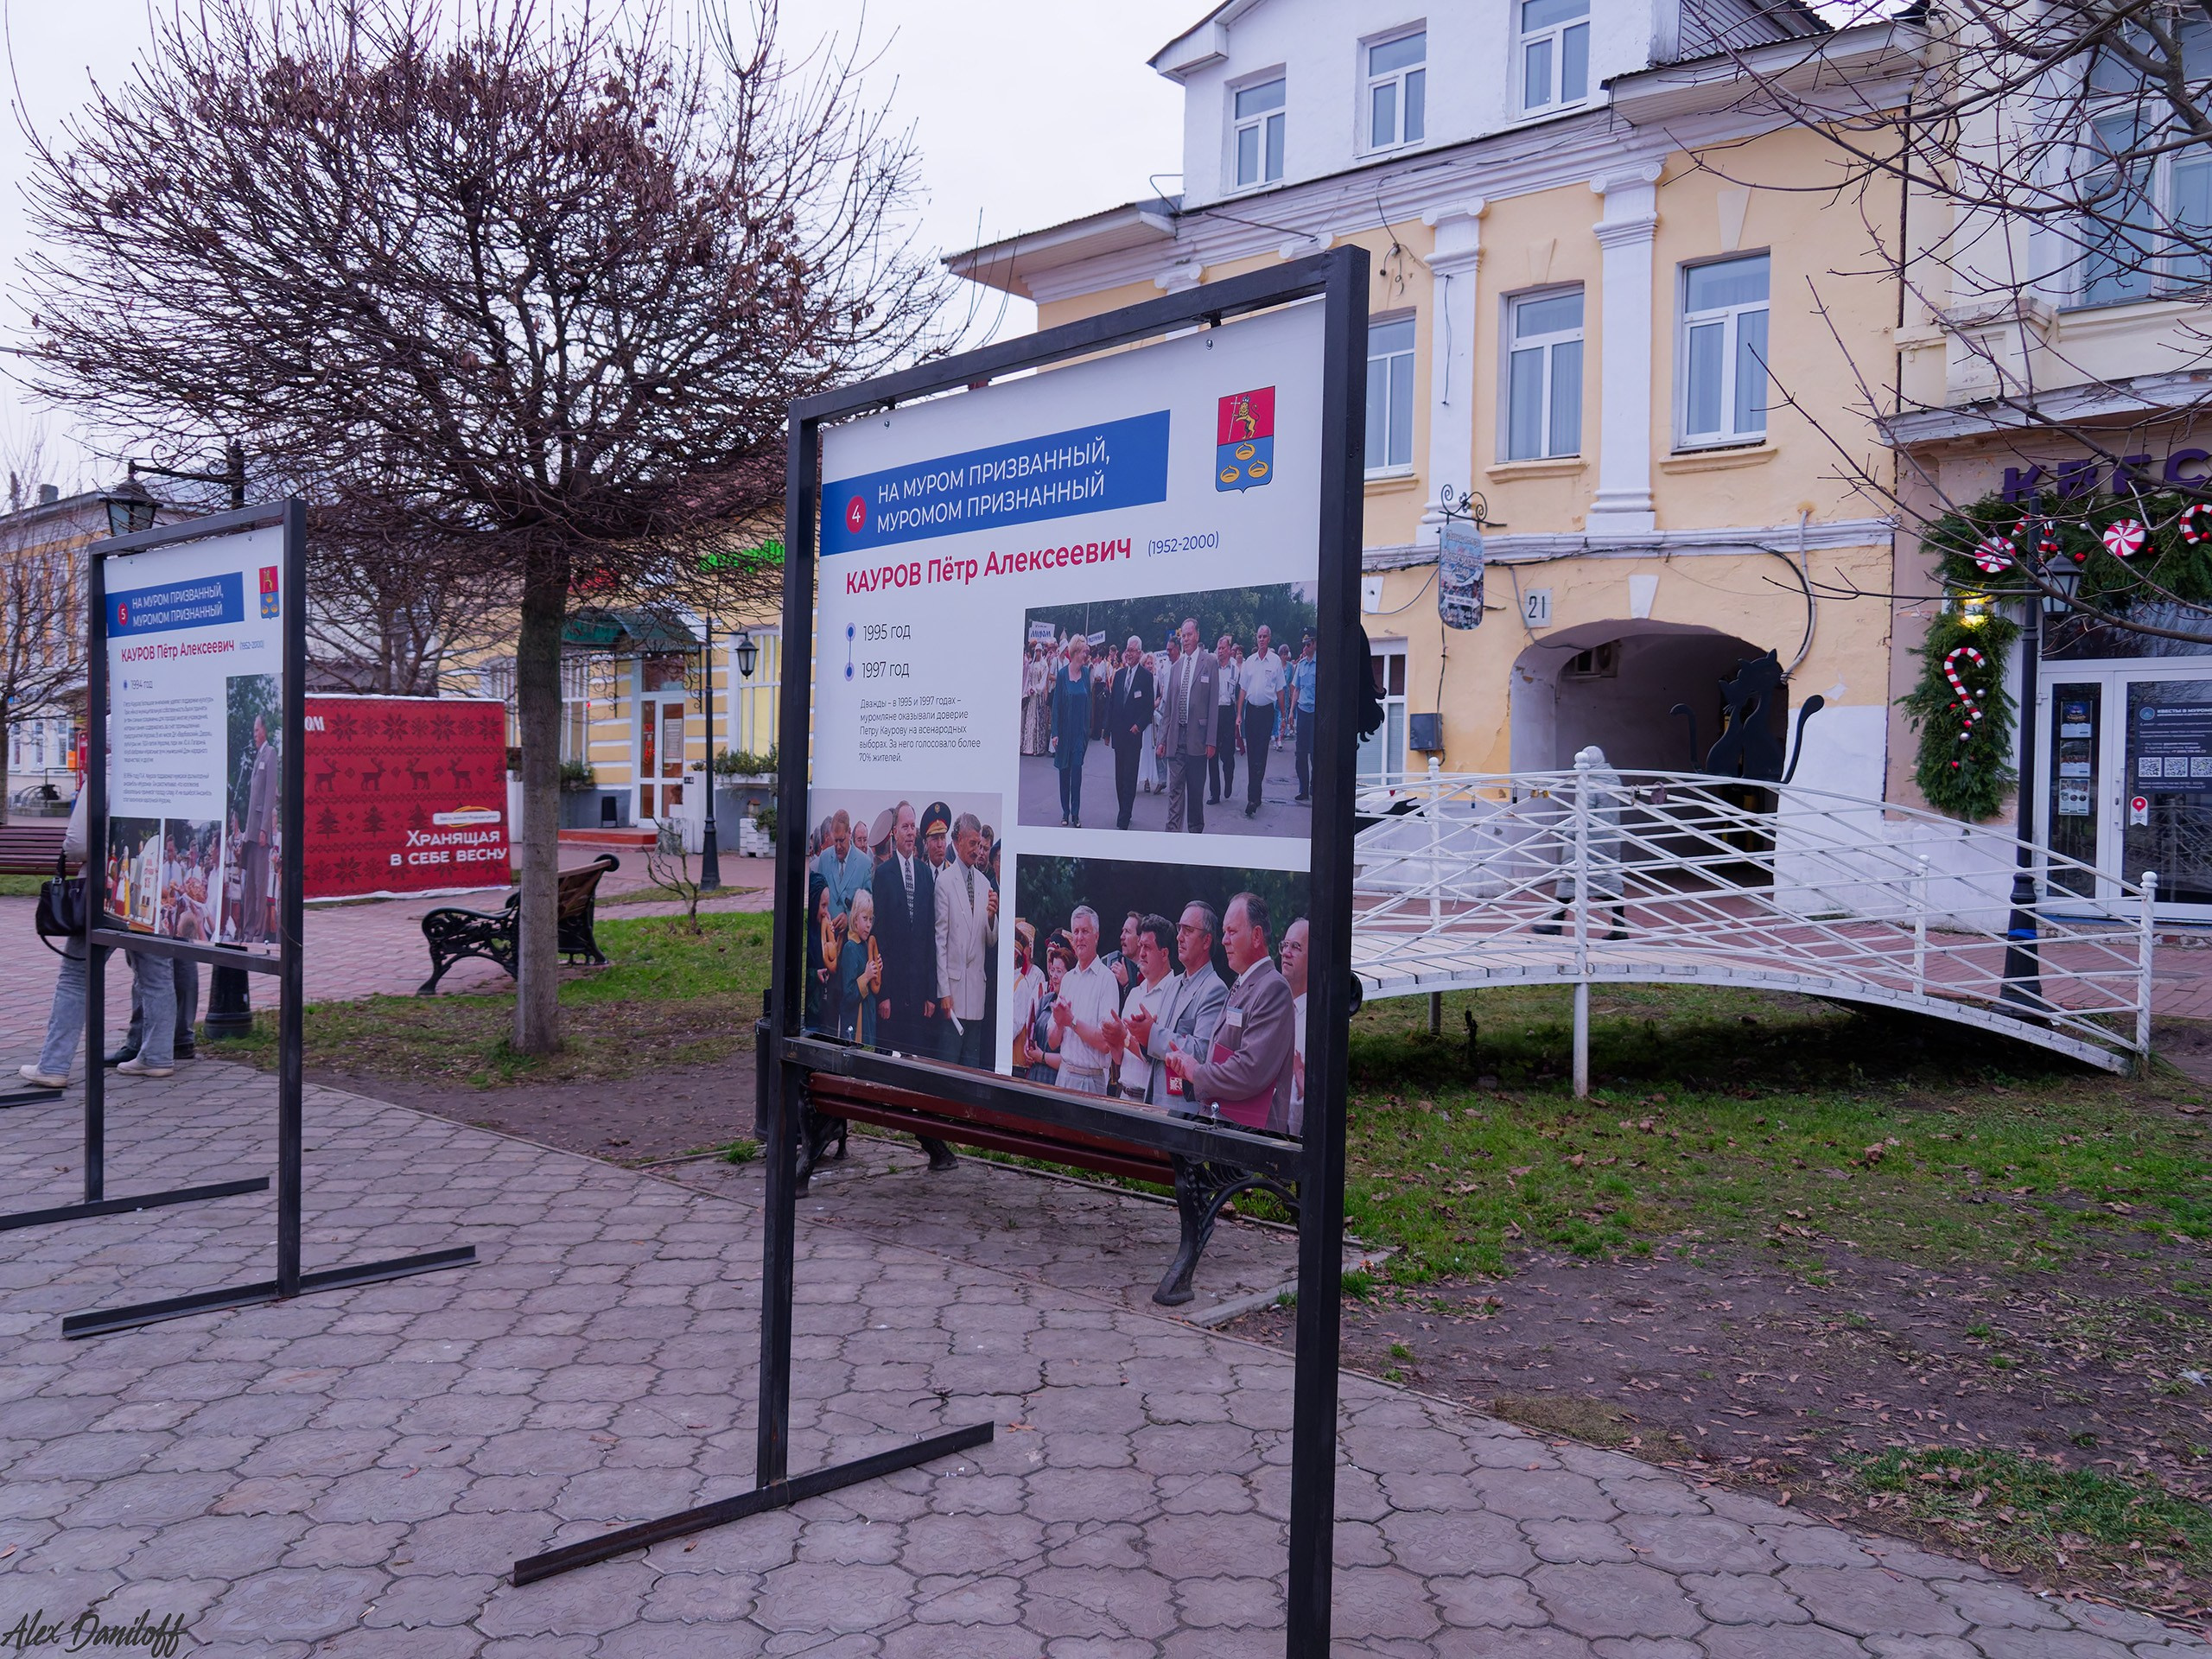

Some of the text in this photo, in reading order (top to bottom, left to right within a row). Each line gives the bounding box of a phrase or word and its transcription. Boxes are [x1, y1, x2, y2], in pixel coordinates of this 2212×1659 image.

[878, 435, 1110, 504] НА МУРОМ ПРИЗВАННЫЙ,
[877, 469, 1105, 533] МУРОМОМ ПРИЗНАННЫЙ
[851, 505, 861, 523] 4
[846, 531, 1219, 594] КАУРОВ Пётр Алексеевич (1952-2000)
[132, 582, 224, 609] НА МУРОМ ПРИЗВАННЫЙ,
[121, 608, 126, 620] 5
[133, 601, 223, 626] МУРОМОМ ПРИЗНАННЫЙ
[1529, 595, 1545, 619] 21
[863, 623, 912, 641] 1995 год
[121, 645, 156, 662] КАУРОВ
[157, 643, 178, 661] Пётр
[180, 639, 235, 658] Алексеевич
[861, 661, 910, 678] 1997 год
[861, 698, 887, 709] Дважды
[898, 696, 912, 707] 1995
[913, 698, 918, 707] и
[919, 696, 935, 706] 1997
[936, 696, 956, 707] годах
[860, 710, 969, 723] муромляне оказывали доверие
[860, 726, 879, 737] Петру
[880, 725, 907, 736] Каурову
[918, 725, 967, 735] всенародных
[889, 739, 897, 748] За
[899, 740, 914, 748] него
[915, 739, 957, 748] голосовало
[957, 738, 981, 748] более
[859, 753, 902, 762] 70% жителей.
